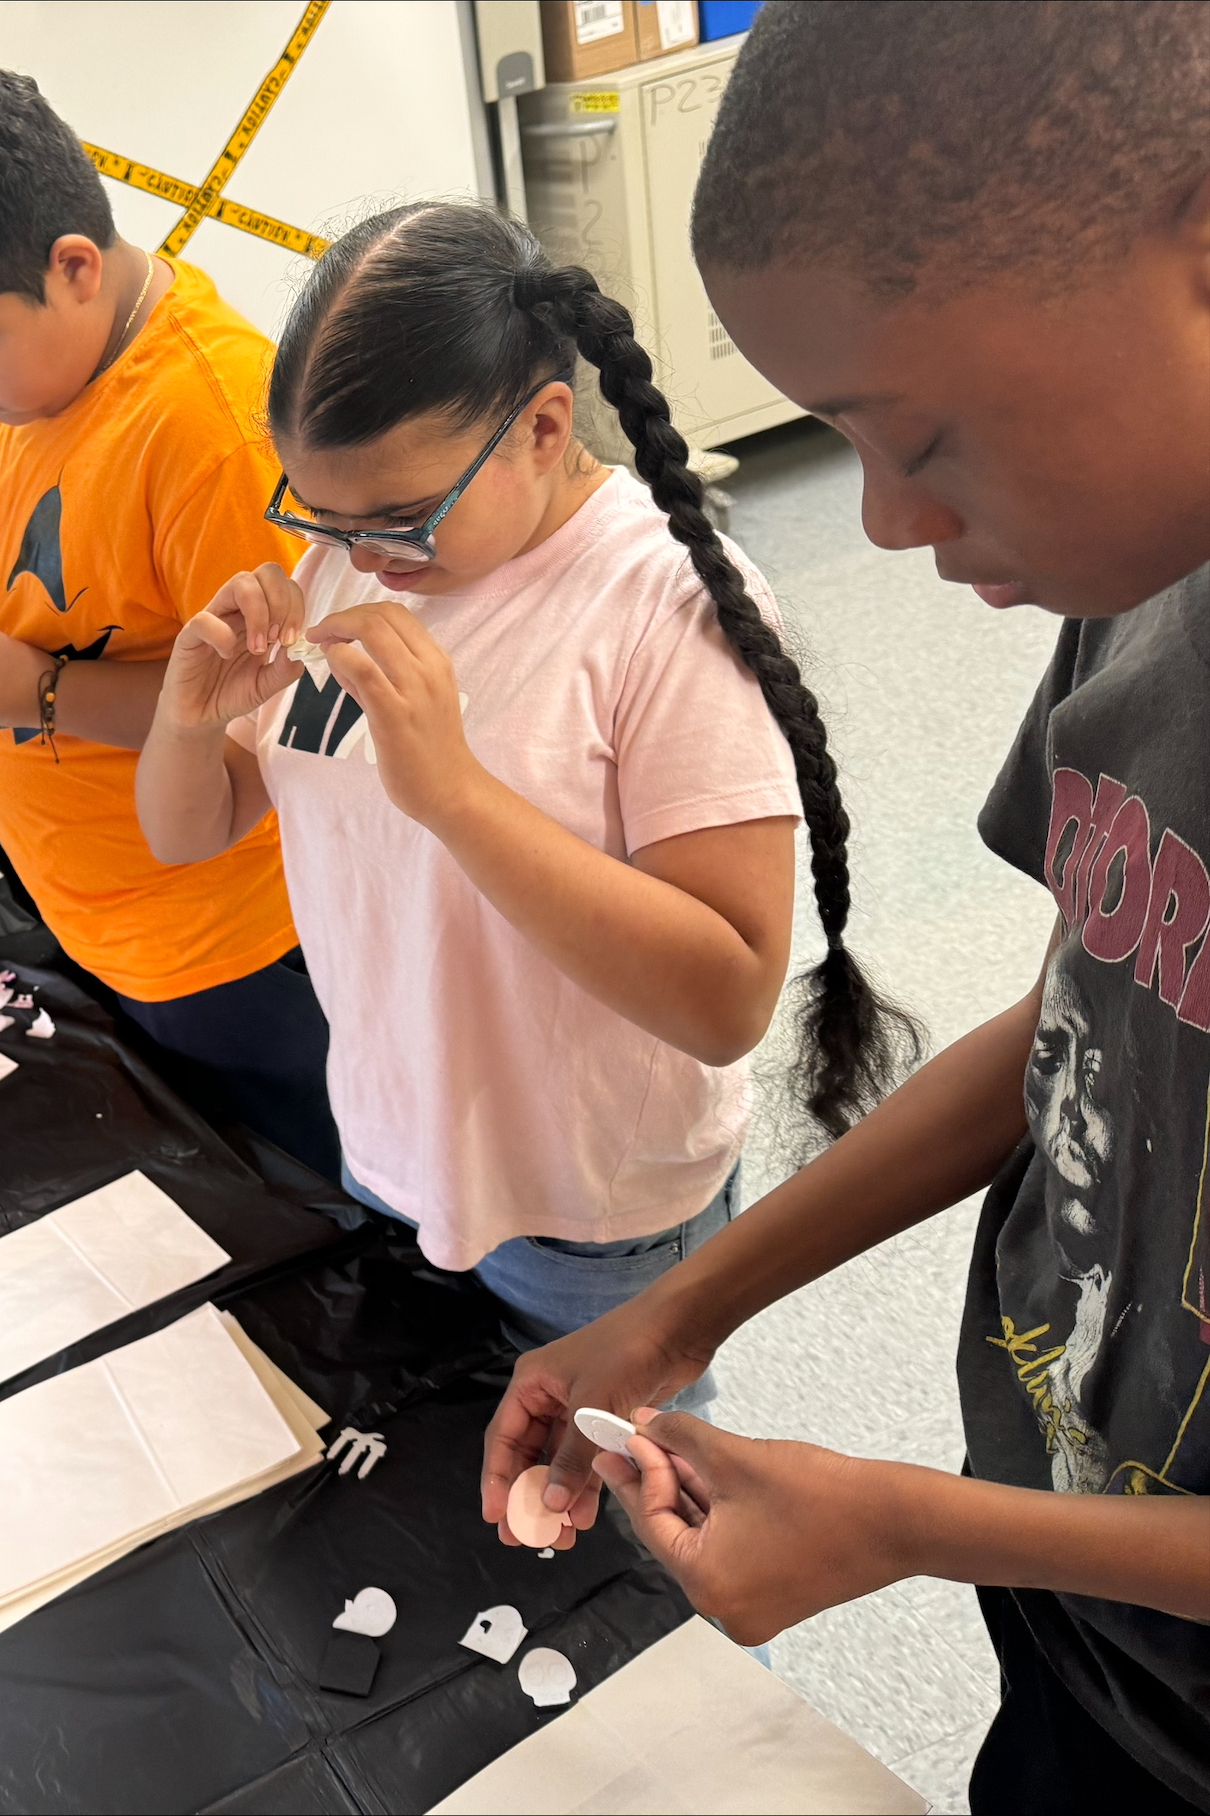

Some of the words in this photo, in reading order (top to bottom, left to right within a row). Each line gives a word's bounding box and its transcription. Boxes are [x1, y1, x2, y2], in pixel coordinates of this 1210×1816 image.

[241, 76, 280, 136] CAUTION
[146, 173, 198, 203] CAUTIO
[238, 211, 290, 242] CAUTION
